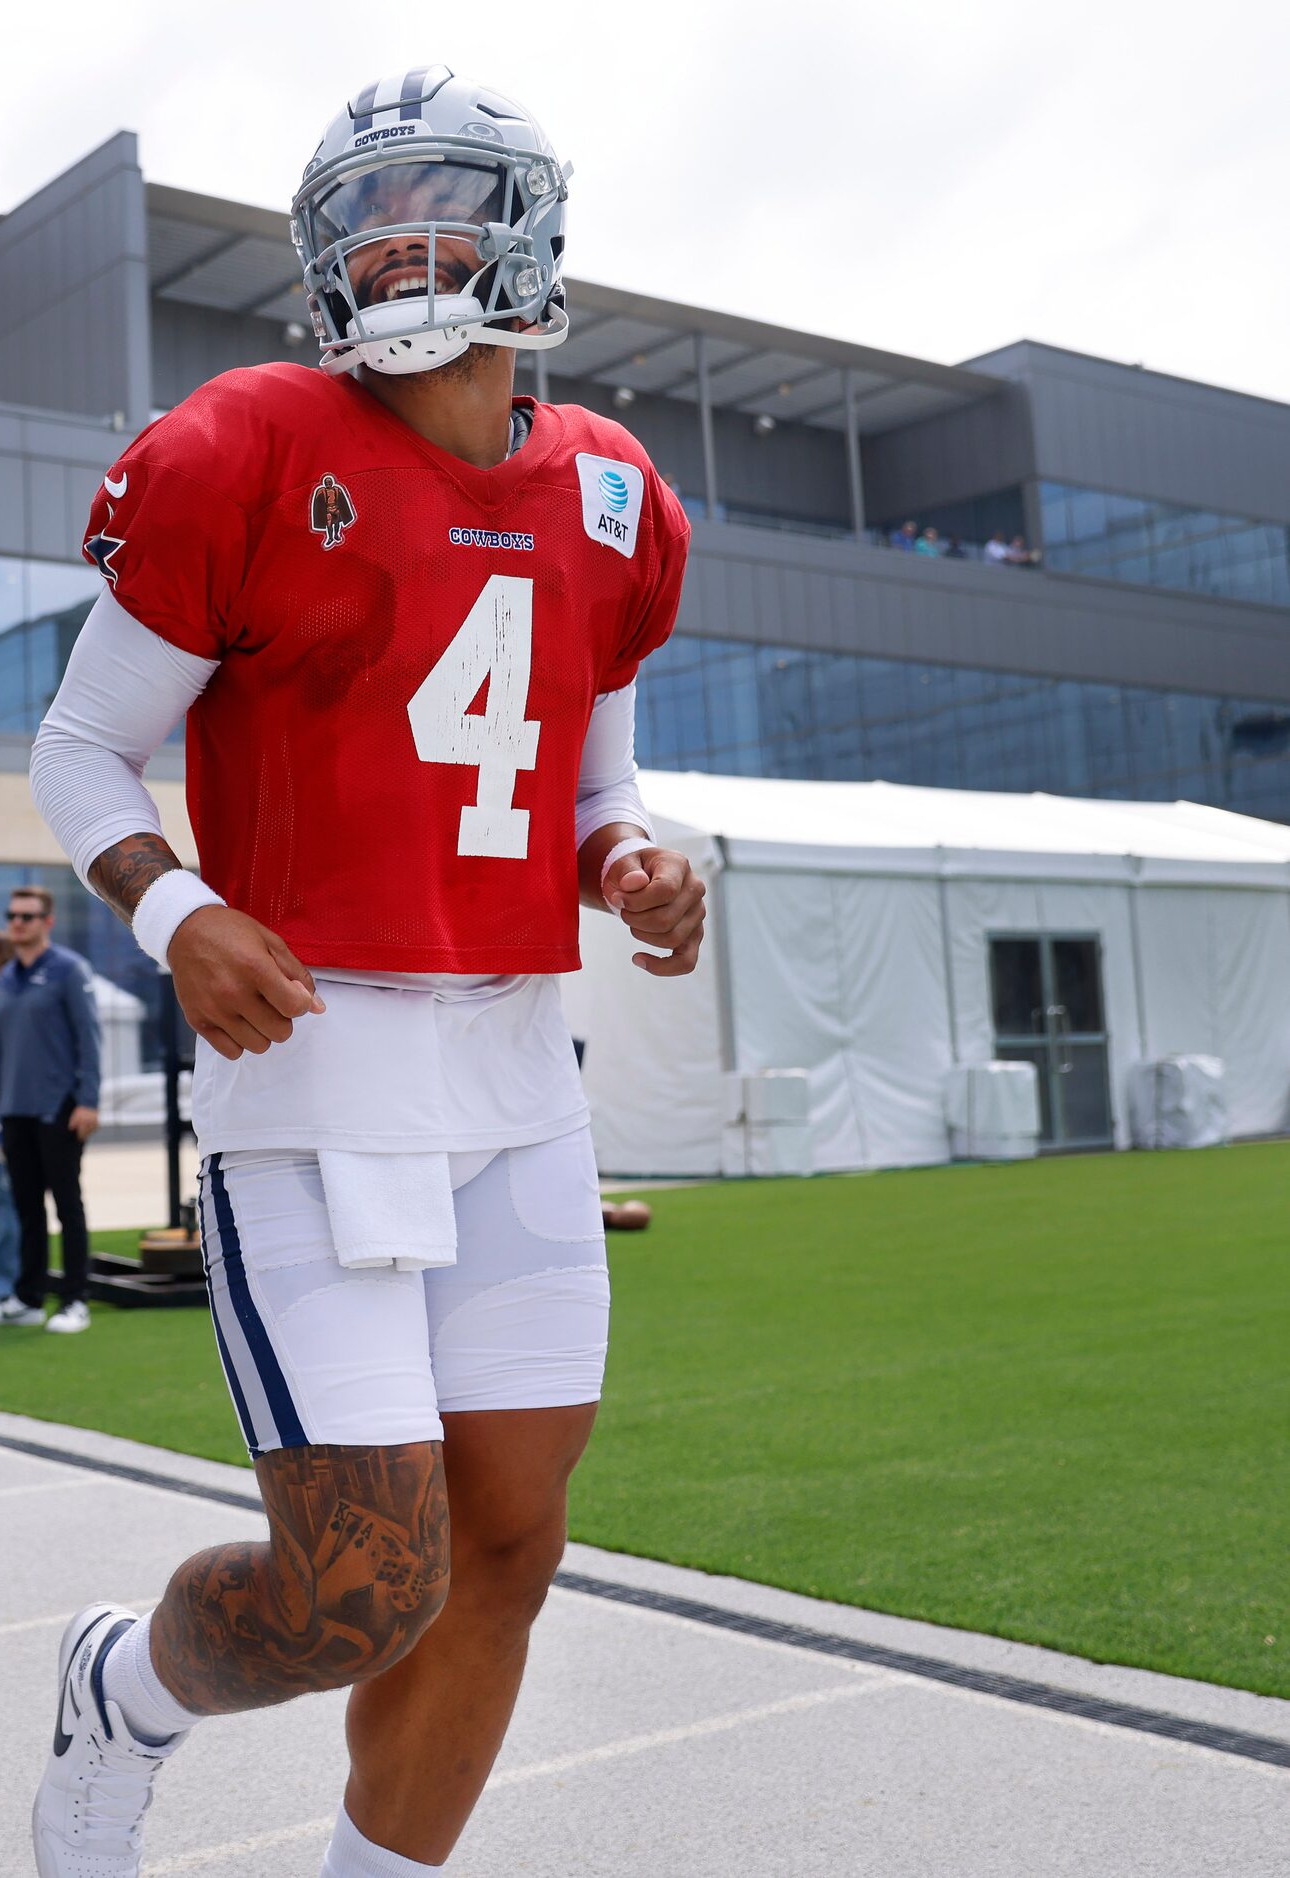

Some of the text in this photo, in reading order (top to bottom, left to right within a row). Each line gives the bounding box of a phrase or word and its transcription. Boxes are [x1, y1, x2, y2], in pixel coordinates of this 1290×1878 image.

[354, 125, 416, 148] COWBOYS
[449, 527, 534, 550] COWBOYS
[598, 513, 629, 543] AT&T
[407, 574, 541, 860] 4
[334, 1501, 350, 1522] K
[360, 1522, 374, 1540] A
